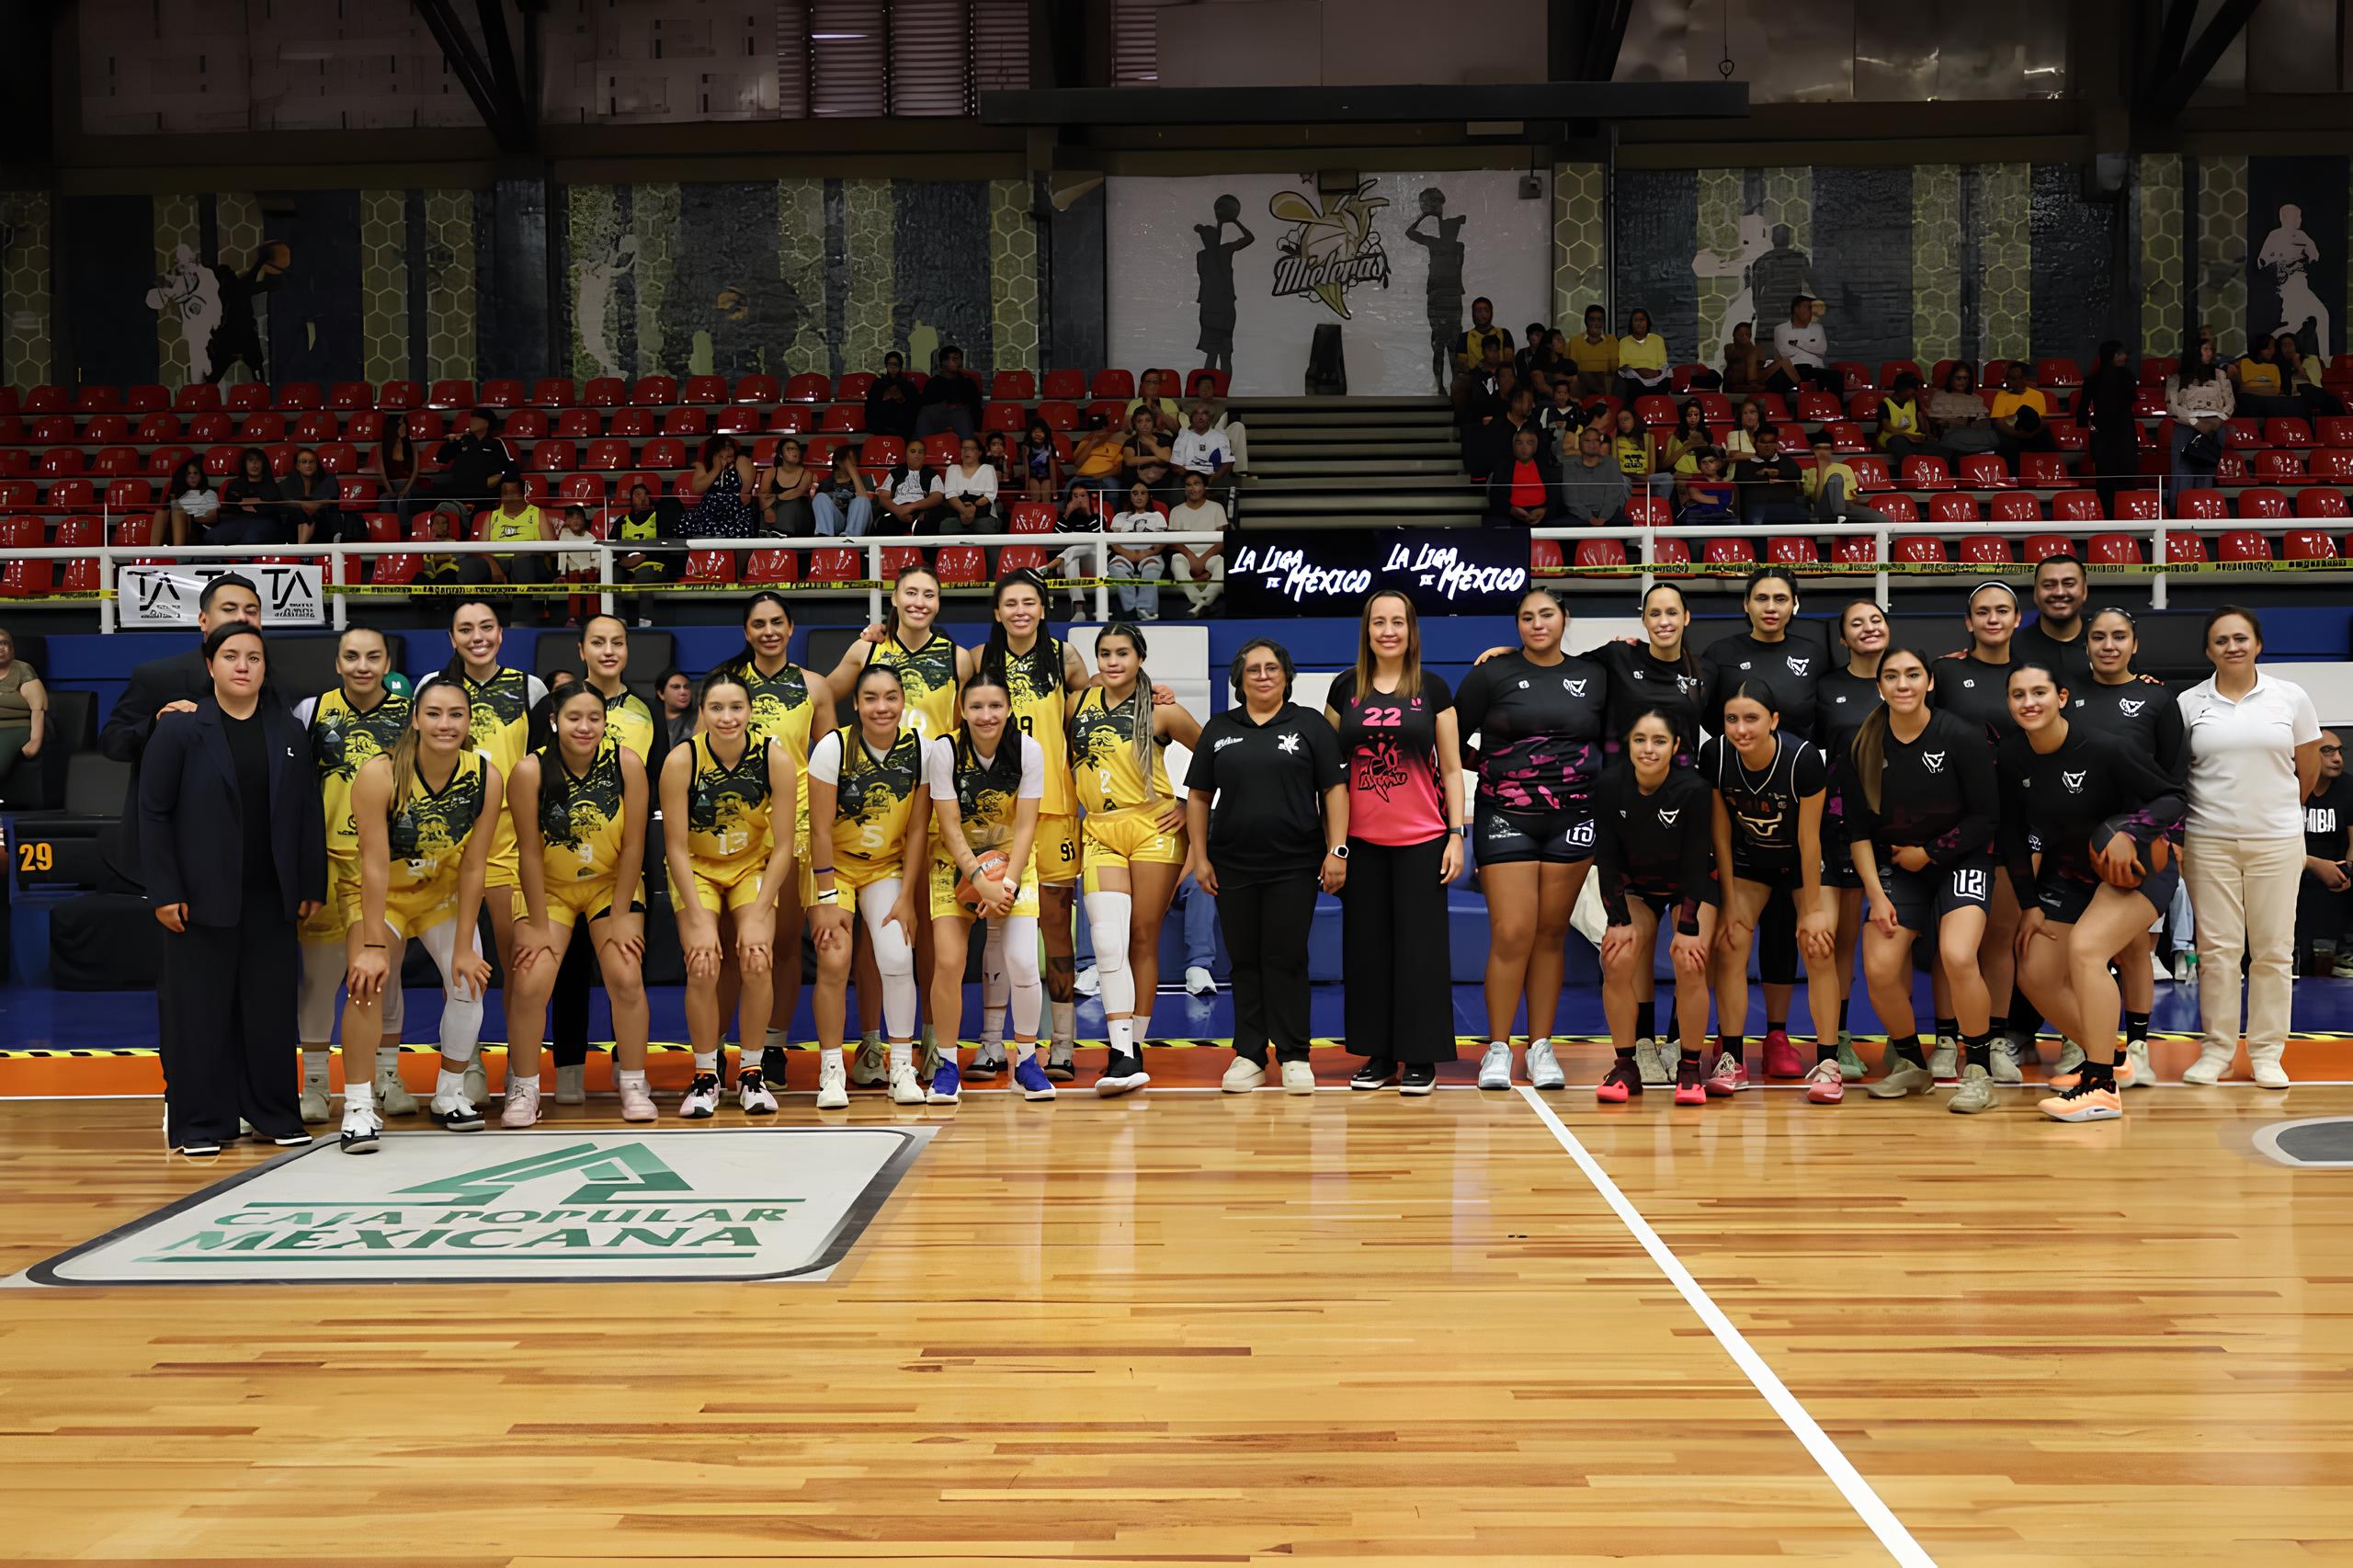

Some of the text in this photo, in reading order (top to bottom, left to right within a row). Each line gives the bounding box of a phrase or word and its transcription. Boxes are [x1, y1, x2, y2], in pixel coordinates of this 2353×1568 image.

[1228, 546, 1303, 574] LA LIGA
[1381, 543, 1458, 572] LA LIGA
[1362, 707, 1402, 727] 22
[19, 842, 52, 871] 29
[1958, 869, 1984, 895] 12
[214, 1209, 788, 1228] CAJA POPULAR
[157, 1226, 763, 1251] MEXICANA
